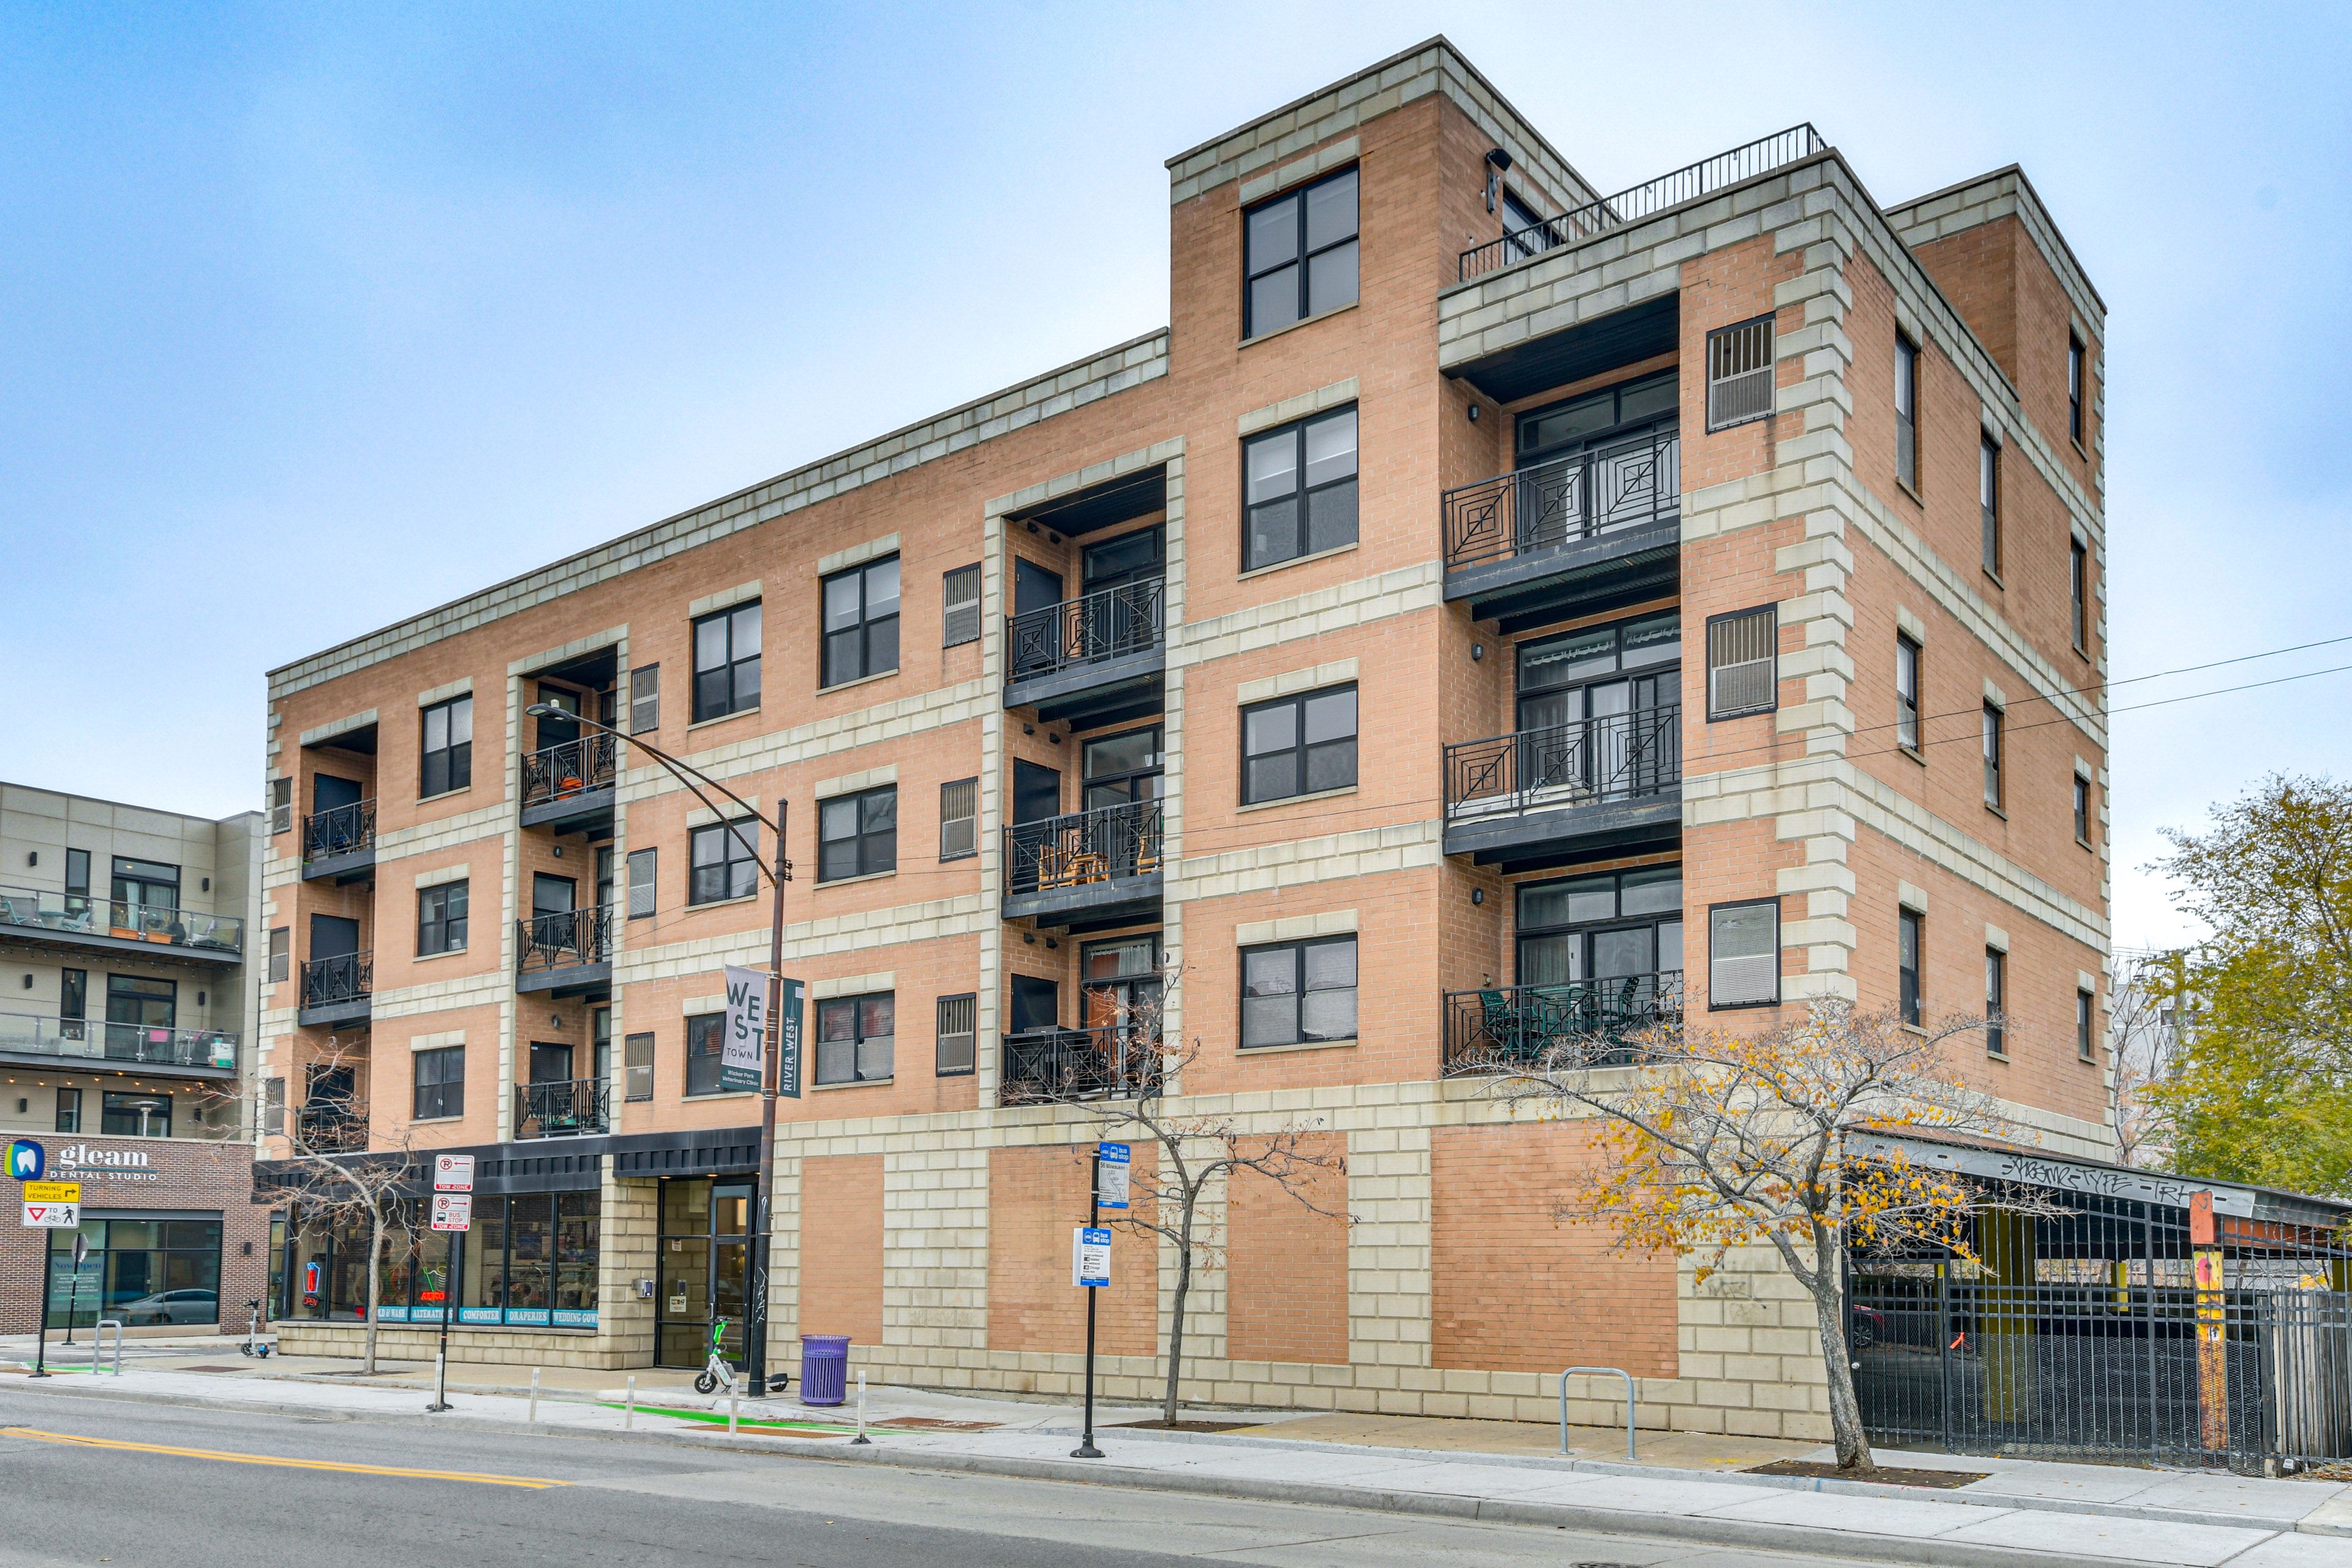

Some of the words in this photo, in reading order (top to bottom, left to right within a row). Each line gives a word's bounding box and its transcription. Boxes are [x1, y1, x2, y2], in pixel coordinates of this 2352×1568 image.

[785, 1017, 794, 1050] WEST
[727, 1047, 753, 1060] TOWN
[783, 1057, 794, 1091] RIVER
[722, 1076, 745, 1085] Veterinary
[59, 1144, 148, 1170] gleam
[50, 1171, 101, 1180] DENTAL
[108, 1172, 157, 1181] STUDIO
[303, 1297, 317, 1306] OPEN
[391, 1308, 405, 1317] WASH
[412, 1309, 453, 1319] ALTERATIOS
[463, 1310, 500, 1320] COMFORTER
[510, 1311, 547, 1321] DRAPERIES
[553, 1312, 581, 1322] WEDDING
